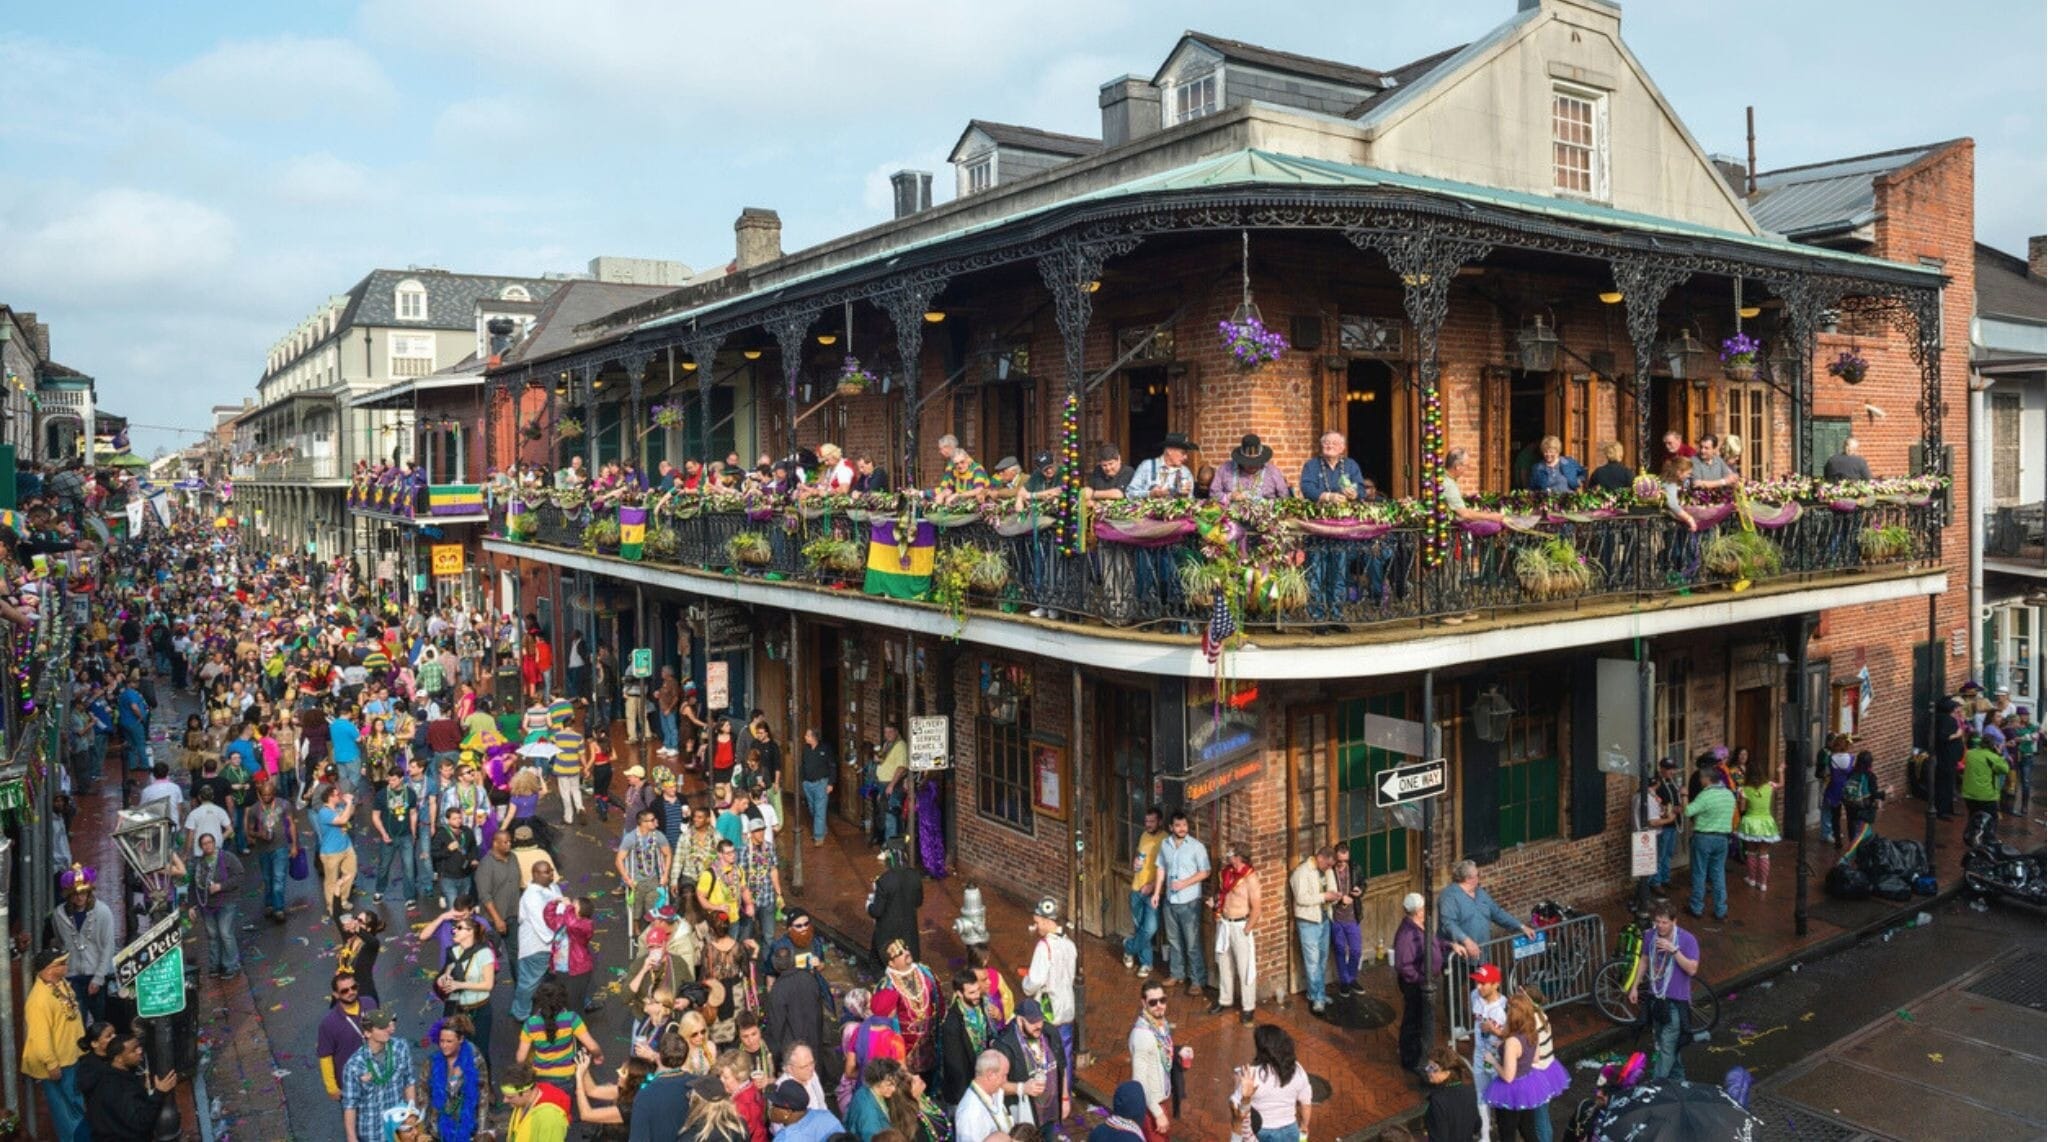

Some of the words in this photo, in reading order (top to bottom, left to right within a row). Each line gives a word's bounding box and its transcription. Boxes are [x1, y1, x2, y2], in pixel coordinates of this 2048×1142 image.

[913, 742, 944, 751] VEHICLS
[1400, 776, 1419, 791] ONE
[1421, 771, 1441, 786] WAY
[119, 953, 143, 982] St.
